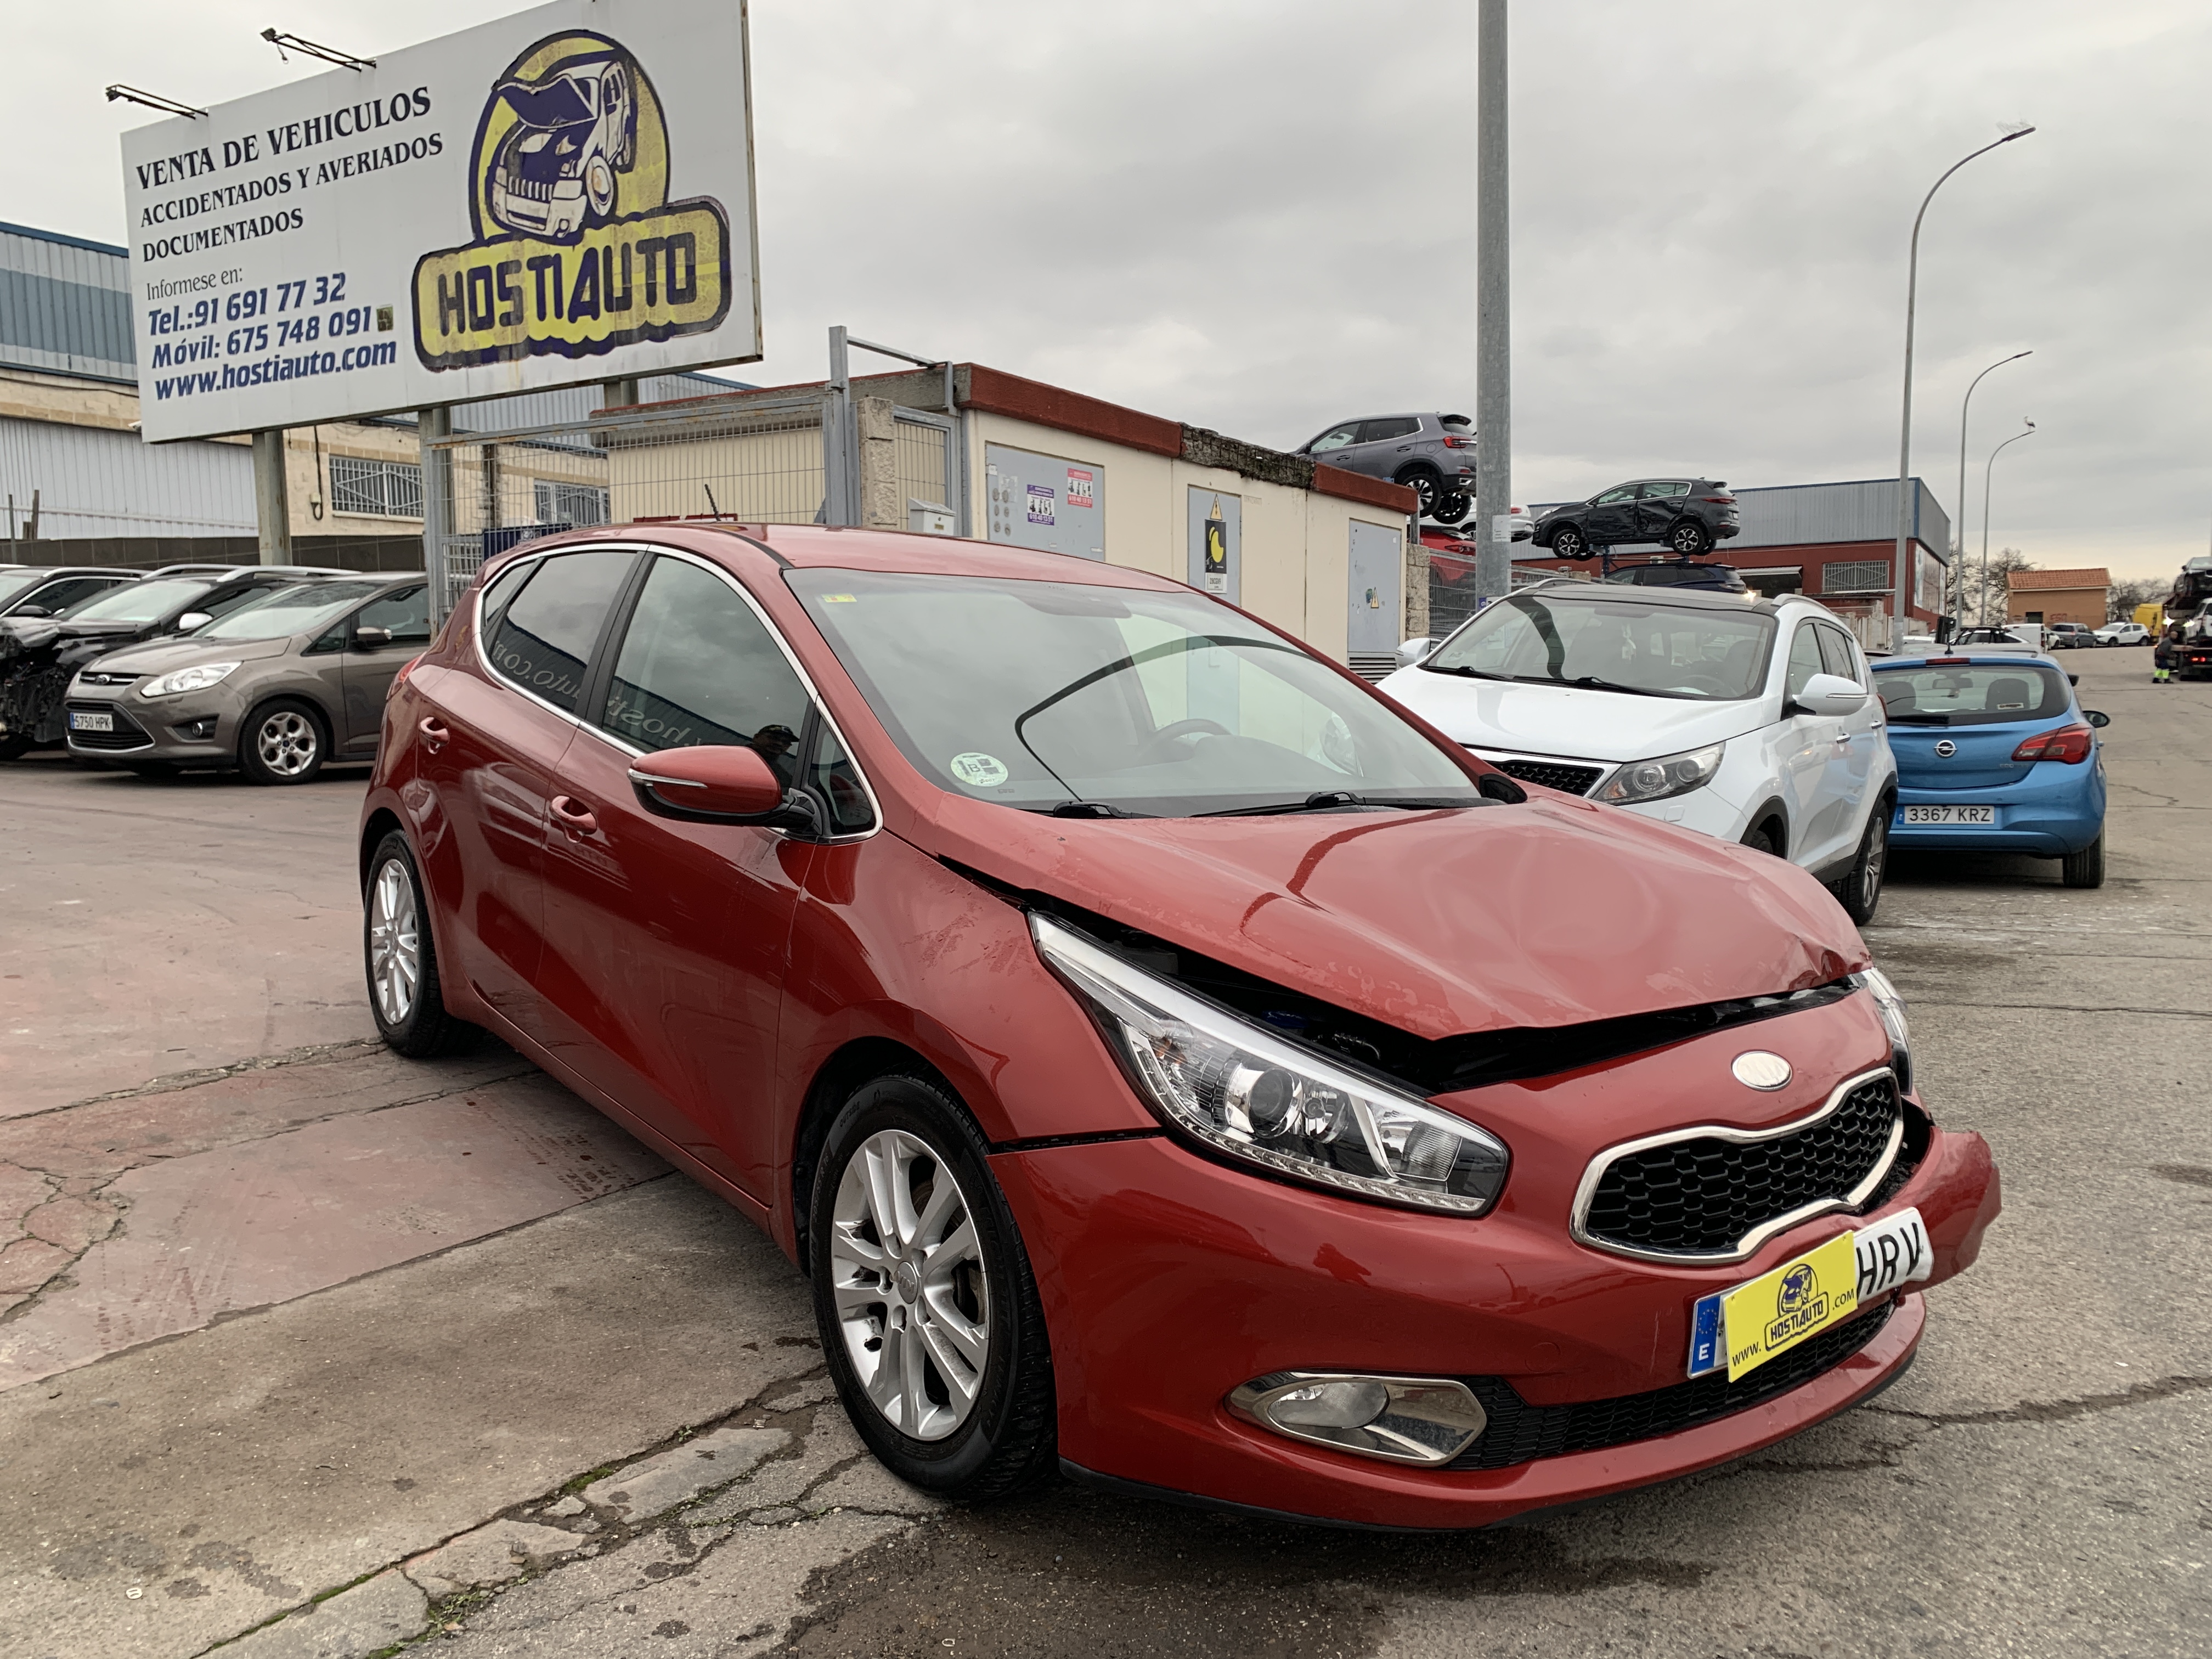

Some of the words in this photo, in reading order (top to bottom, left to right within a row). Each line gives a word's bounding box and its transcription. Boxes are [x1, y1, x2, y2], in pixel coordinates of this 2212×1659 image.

[137, 147, 216, 189] VENTA
[223, 134, 259, 168] DE
[267, 87, 430, 155] VEHICULOS
[142, 173, 291, 227] ACCIDENTADOS
[297, 167, 309, 188] Y
[316, 133, 442, 185] AVERIADOS
[143, 208, 303, 262] DOCUMENTADOS
[147, 275, 217, 301] Informese
[221, 267, 243, 284] en:
[227, 288, 267, 320] 691
[277, 280, 306, 312] 77
[314, 273, 346, 305] 32
[438, 232, 696, 336] HOSTIAUTO
[152, 335, 220, 368] Móvil:
[227, 324, 268, 354] 675
[278, 316, 320, 347] 748
[329, 306, 371, 337] 091
[155, 341, 396, 399] www.hostiauto.com
[1909, 808, 1951, 822] 3367
[1958, 808, 1990, 822] KRZ
[1856, 1222, 1920, 1300] HRV
[1699, 1343, 1710, 1361] E
